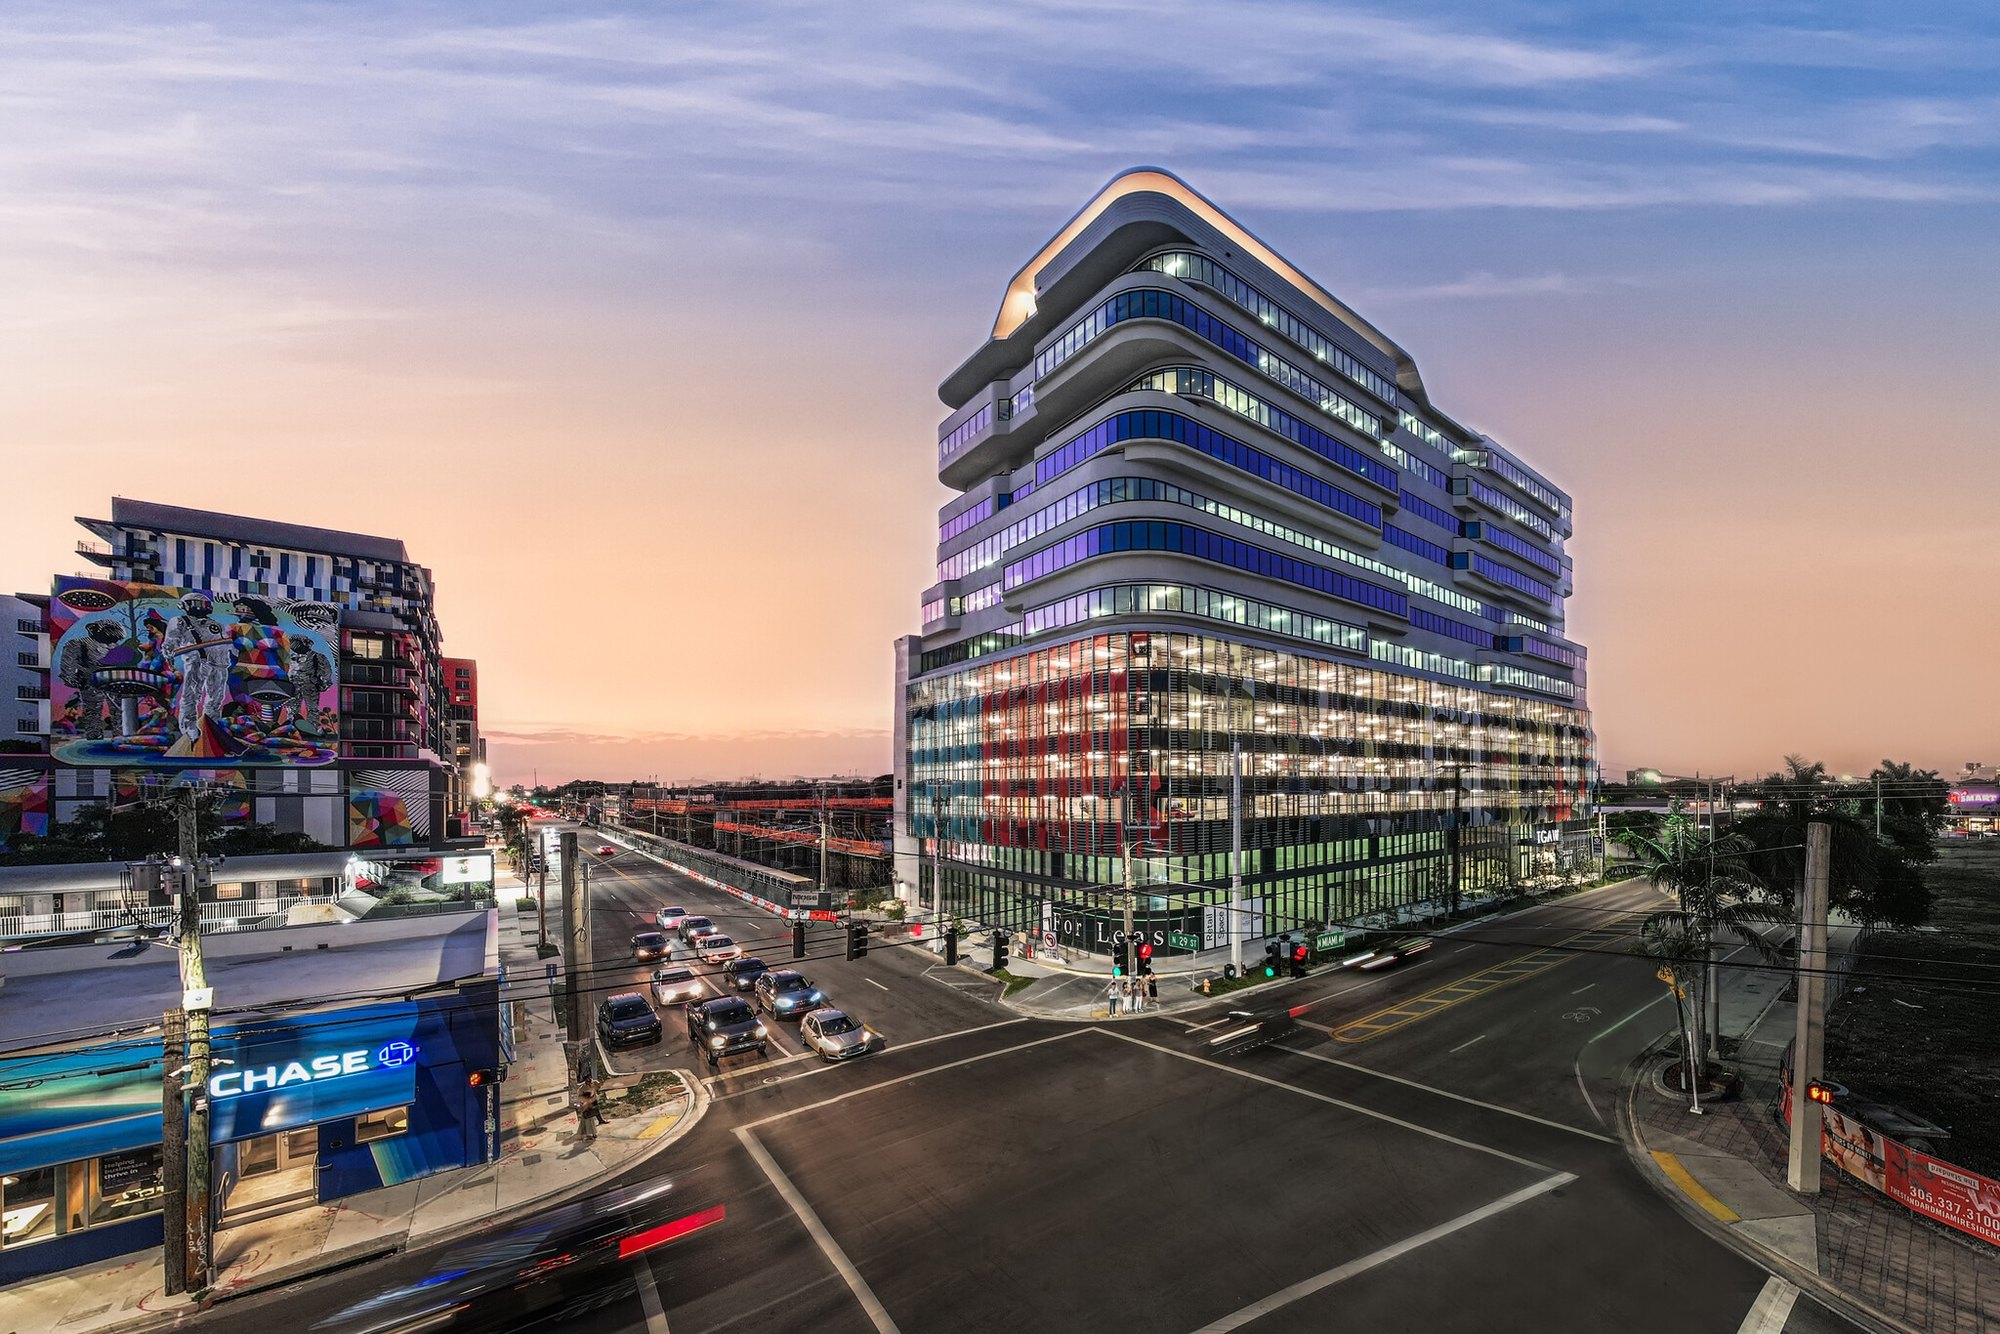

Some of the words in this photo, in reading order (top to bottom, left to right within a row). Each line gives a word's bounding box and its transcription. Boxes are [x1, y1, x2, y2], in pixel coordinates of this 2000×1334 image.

[1053, 912, 1083, 937] For
[1097, 921, 1183, 946] Leas
[1171, 936, 1177, 944] N
[1179, 936, 1188, 947] 29
[1190, 939, 1197, 948] ST
[1322, 934, 1338, 948] MIAMI
[210, 1050, 370, 1097] CHASE
[104, 1159, 135, 1169] Helping
[104, 1162, 147, 1175] businesses
[104, 1170, 128, 1180] thrive
[1930, 1165, 1962, 1182] Standard
[1909, 1185, 2000, 1231] 305.337.3100
